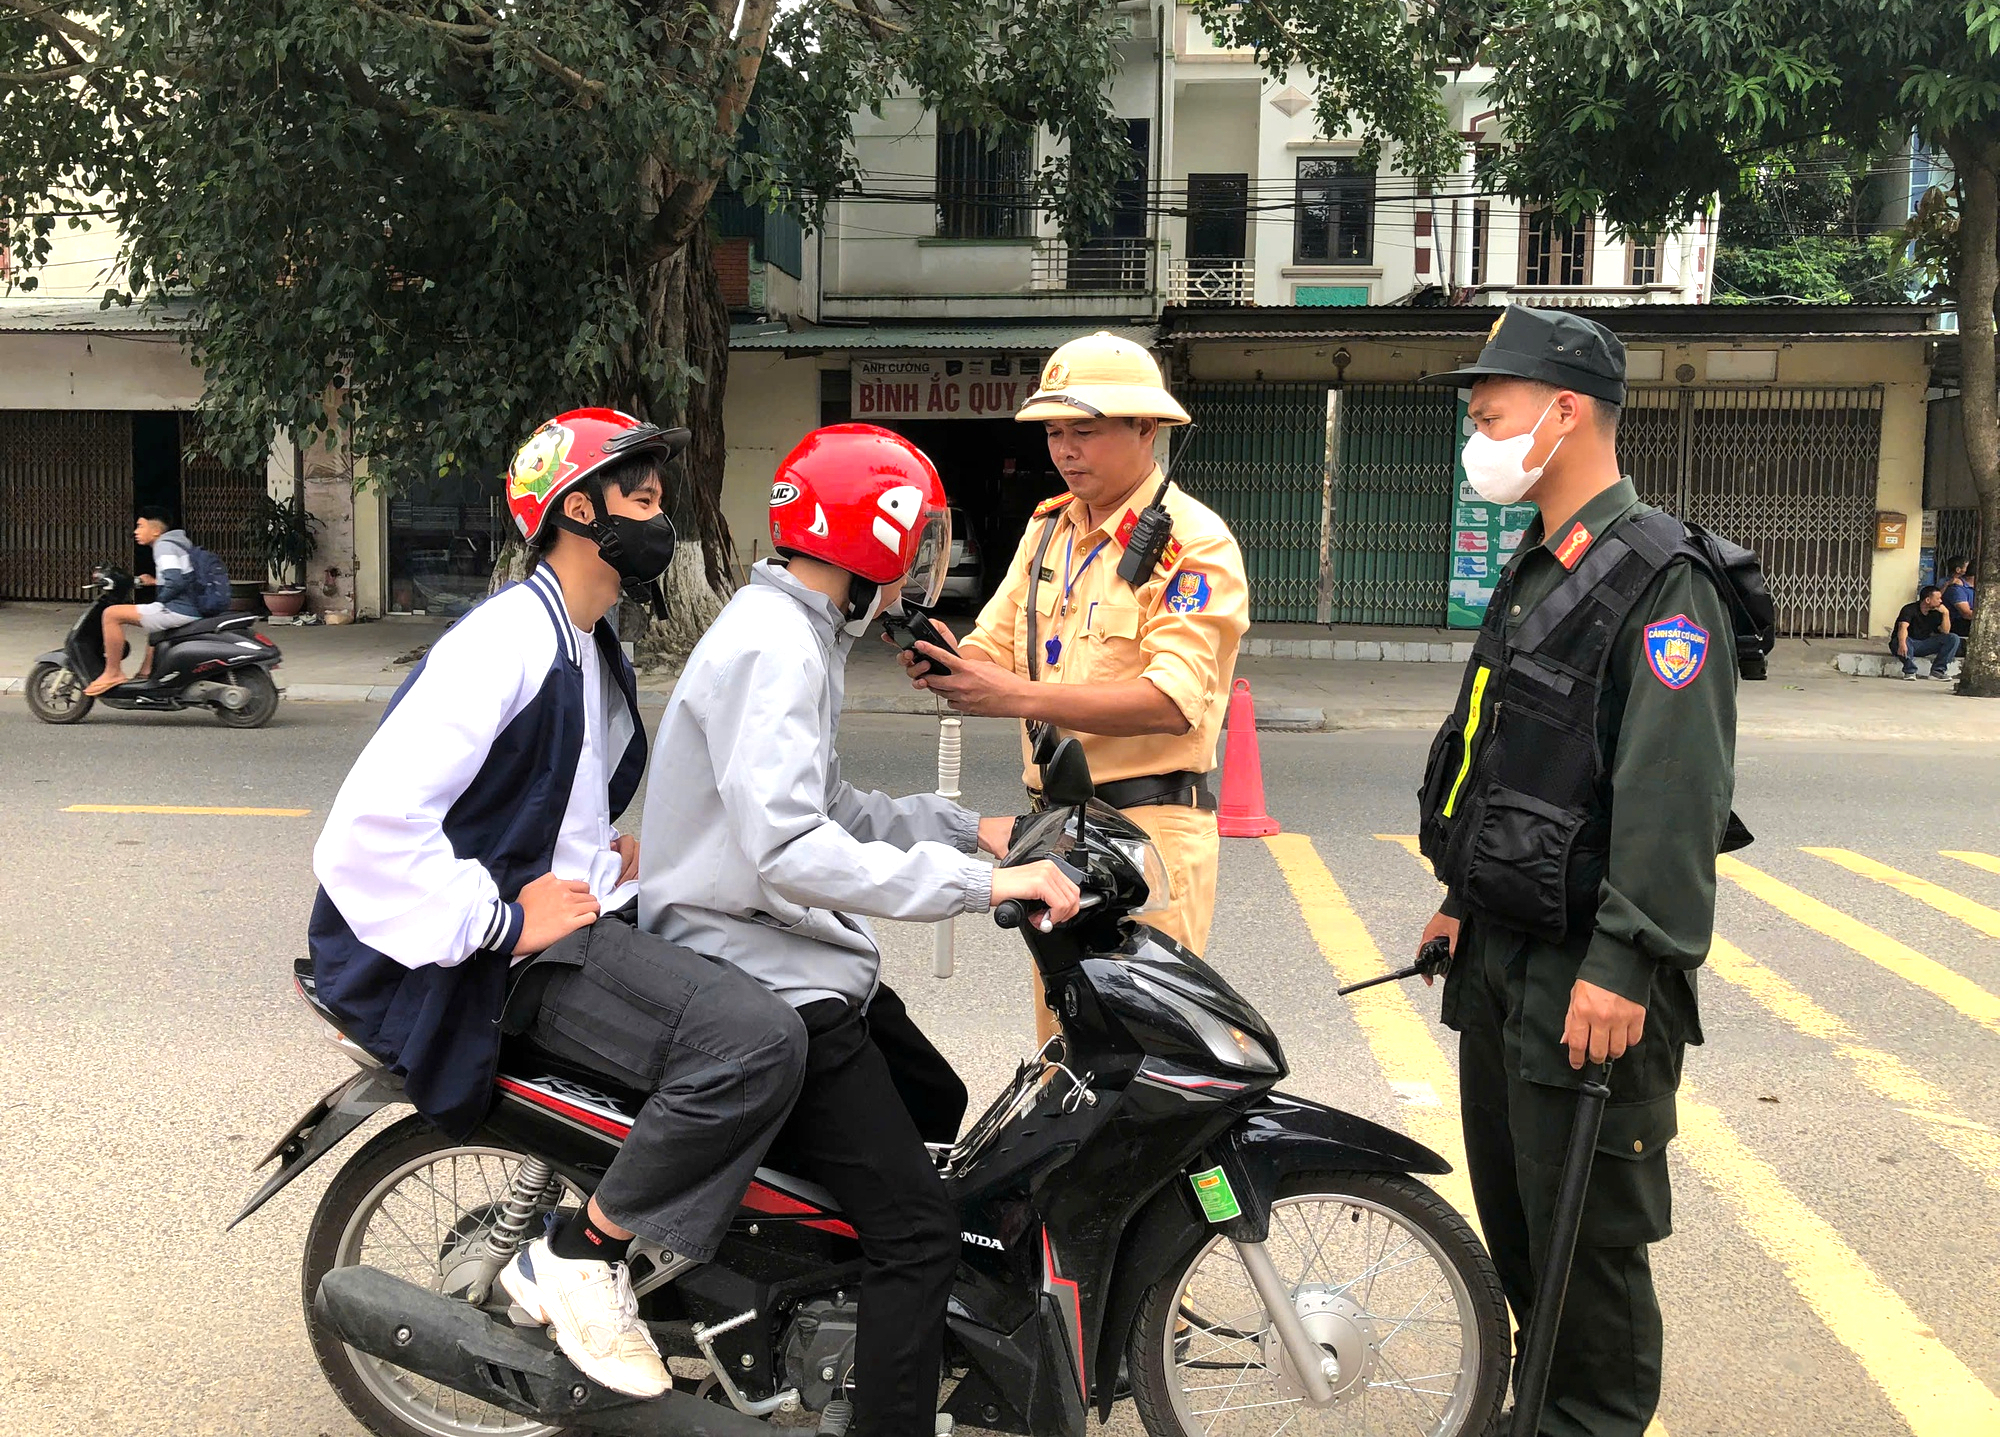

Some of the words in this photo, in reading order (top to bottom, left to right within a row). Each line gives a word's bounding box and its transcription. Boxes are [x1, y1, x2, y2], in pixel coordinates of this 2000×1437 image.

[862, 363, 886, 373] ANH
[859, 378, 918, 412] BÌNH
[926, 372, 960, 412] ẮC
[969, 382, 1016, 414] QUY
